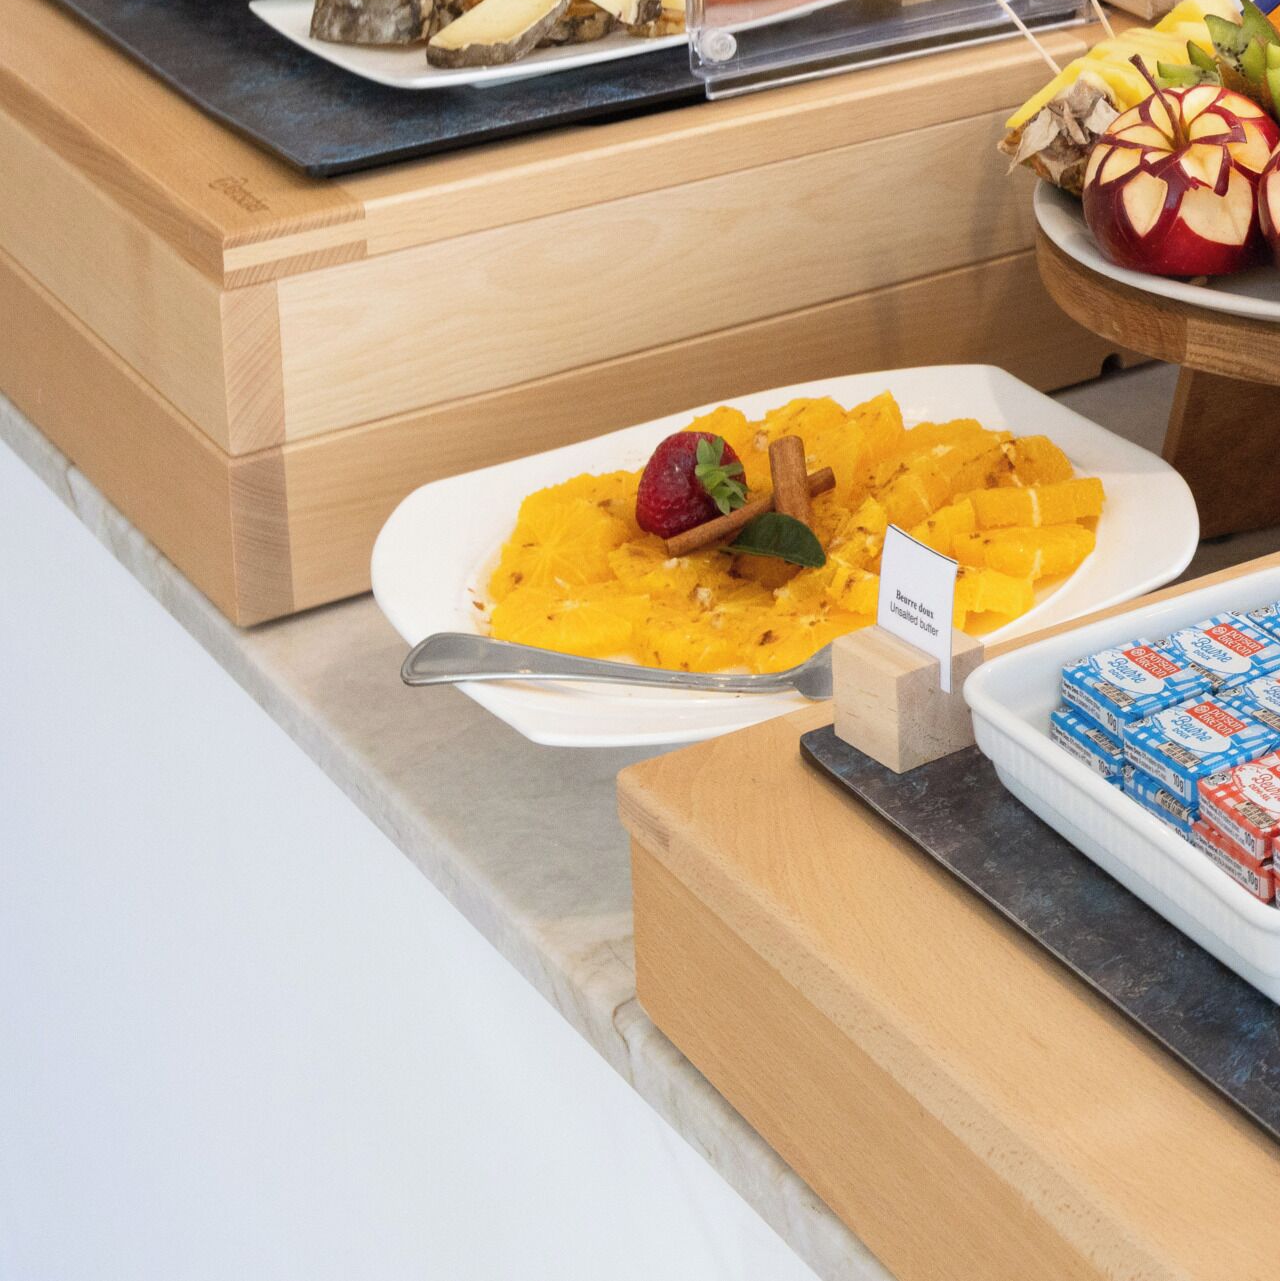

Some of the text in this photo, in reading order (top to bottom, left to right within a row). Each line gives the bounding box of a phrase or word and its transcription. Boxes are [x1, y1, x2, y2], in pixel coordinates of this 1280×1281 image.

[889, 599, 940, 638] Unsalted butter
[895, 589, 935, 620] Beurre doux
[1191, 636, 1233, 664] Beurre
[1107, 657, 1147, 684] Beurre
[1171, 715, 1213, 743] Beurre
[1172, 773, 1184, 794] 10g
